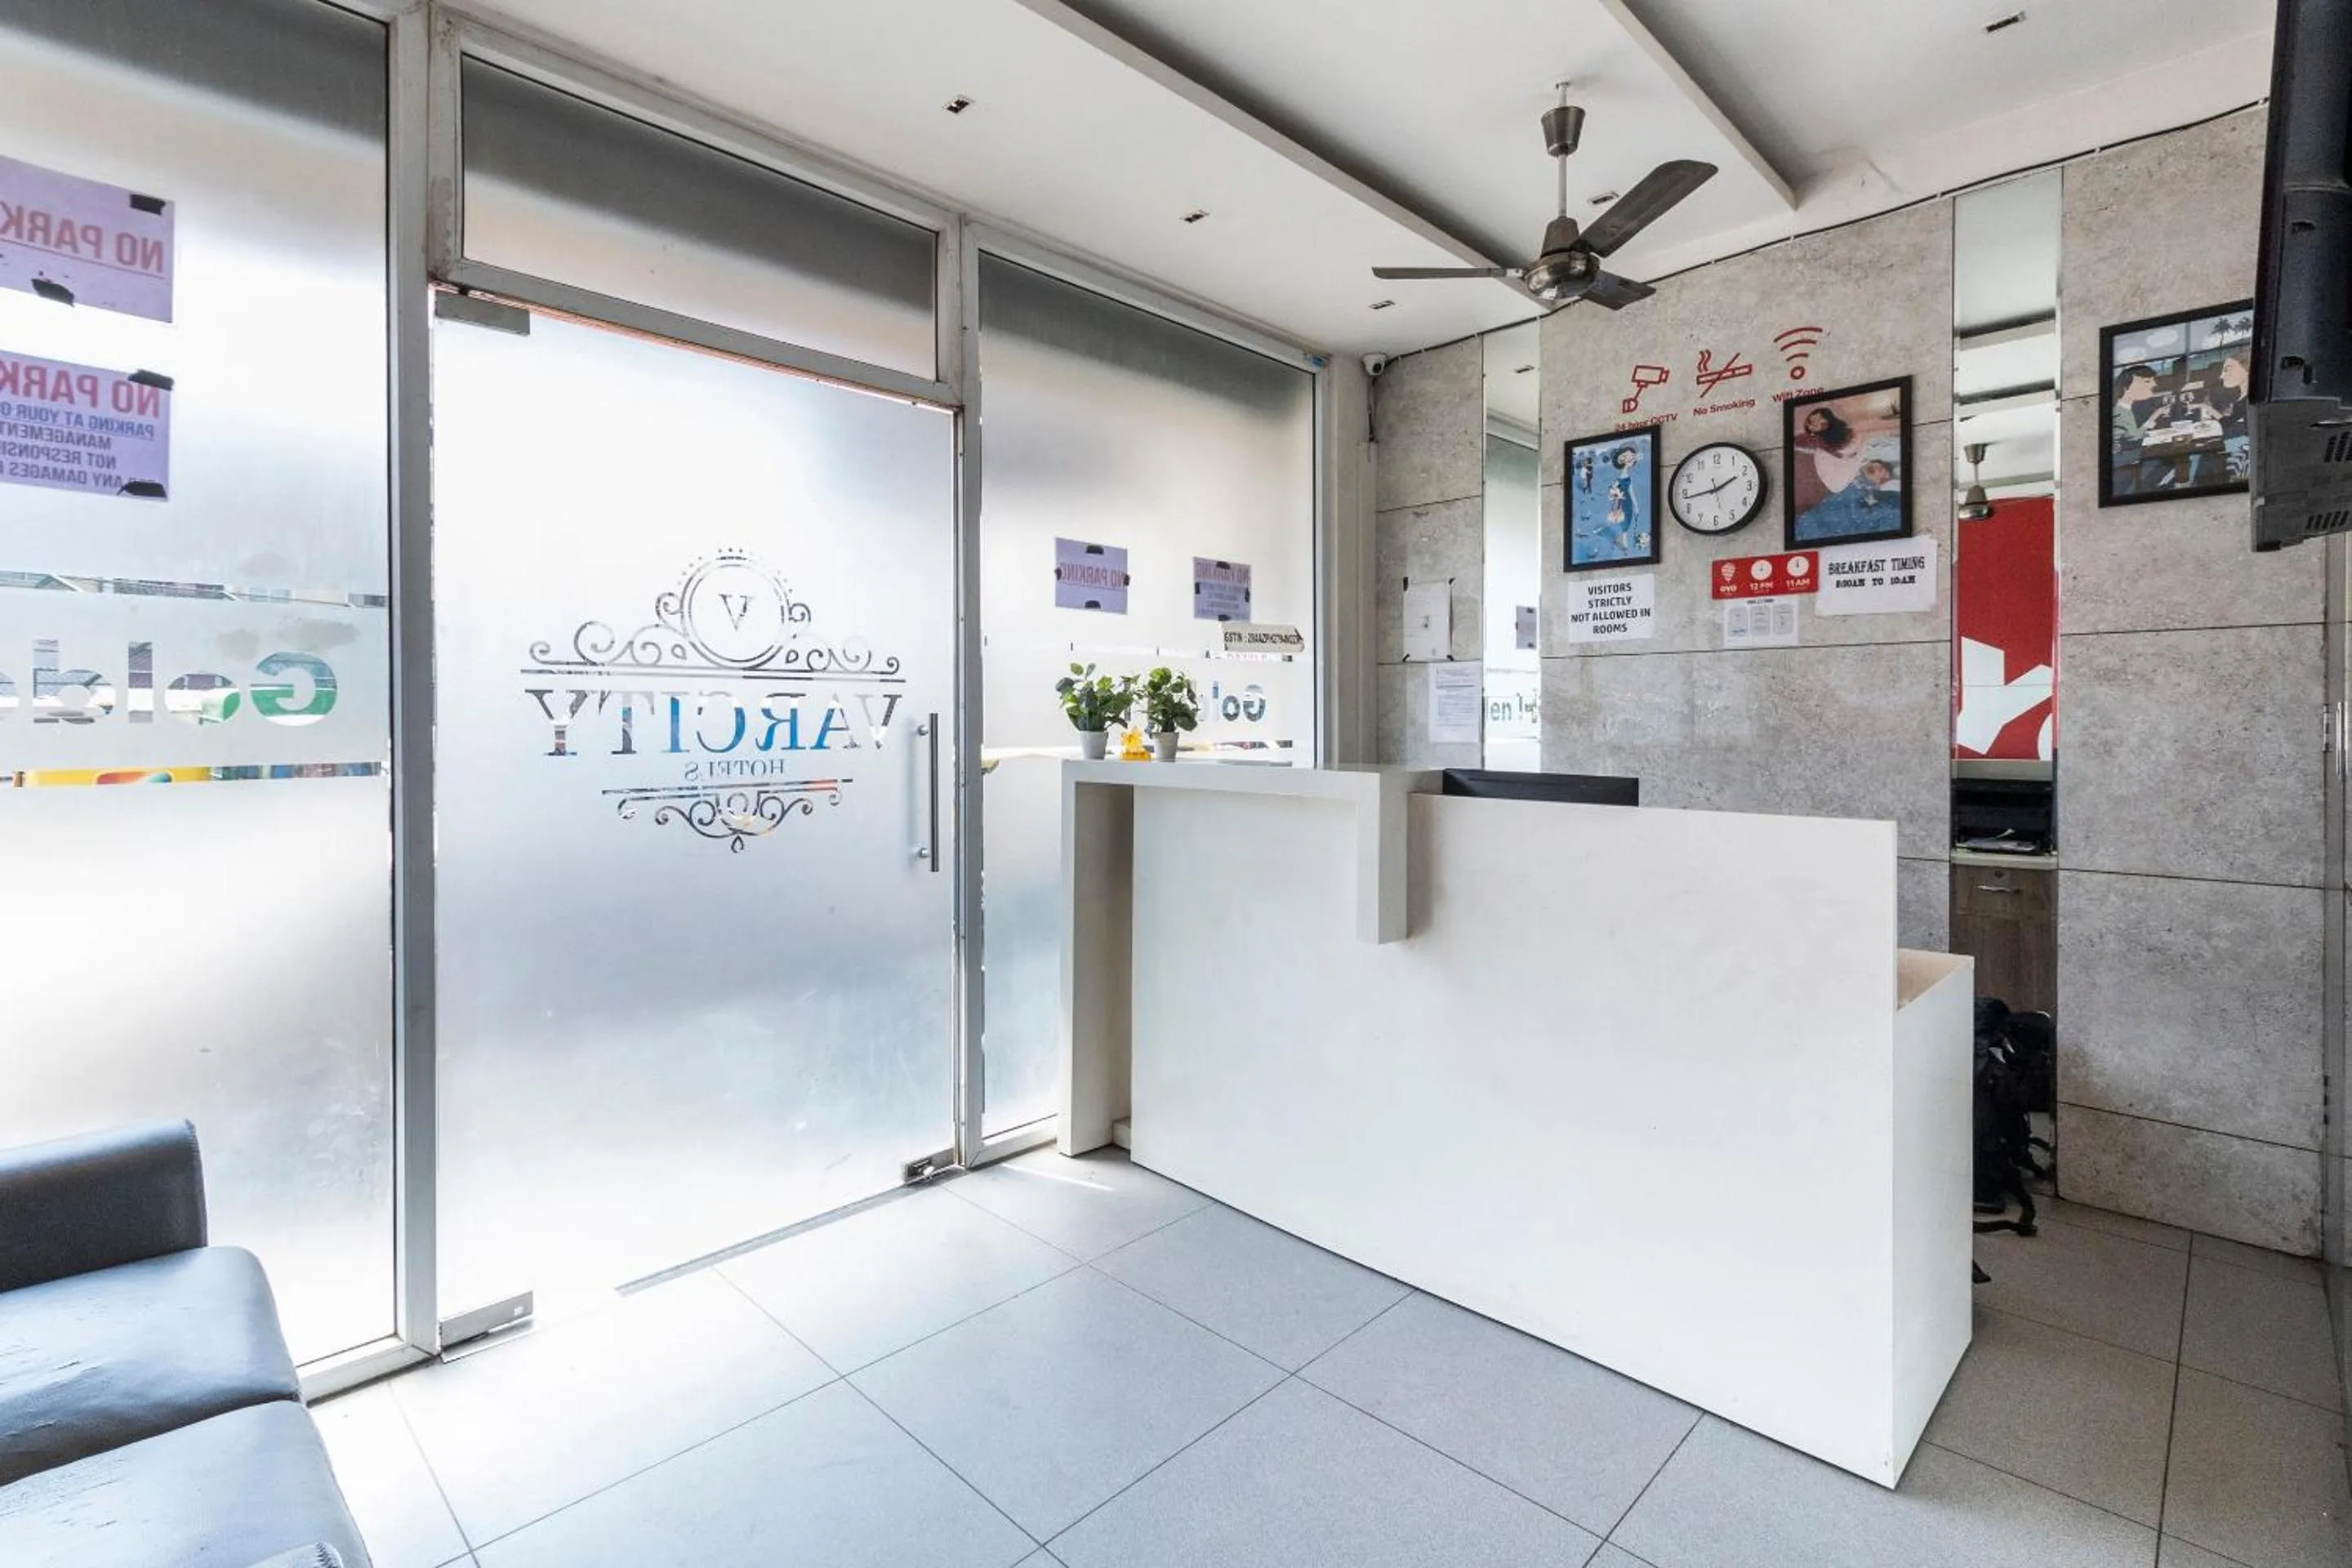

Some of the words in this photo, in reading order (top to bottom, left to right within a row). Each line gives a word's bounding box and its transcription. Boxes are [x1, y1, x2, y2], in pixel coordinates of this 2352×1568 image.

[1693, 408, 1708, 416] No
[1710, 399, 1756, 413] Smoking
[1713, 453, 1722, 466] 12
[1741, 465, 1748, 476] 2
[1746, 479, 1753, 492] 3
[1713, 514, 1720, 527] 6
[1828, 559, 1886, 575] BREAKFAST
[1891, 556, 1925, 572] TIMING
[1588, 582, 1632, 595] VISITORS
[1872, 578, 1884, 586] TO
[1588, 596, 1632, 608] STRICTLY
[1570, 612, 1590, 622] NOT
[1592, 609, 1637, 621] ALLOWED
[1640, 608, 1650, 617] IN
[1592, 622, 1628, 634] ROOMS
